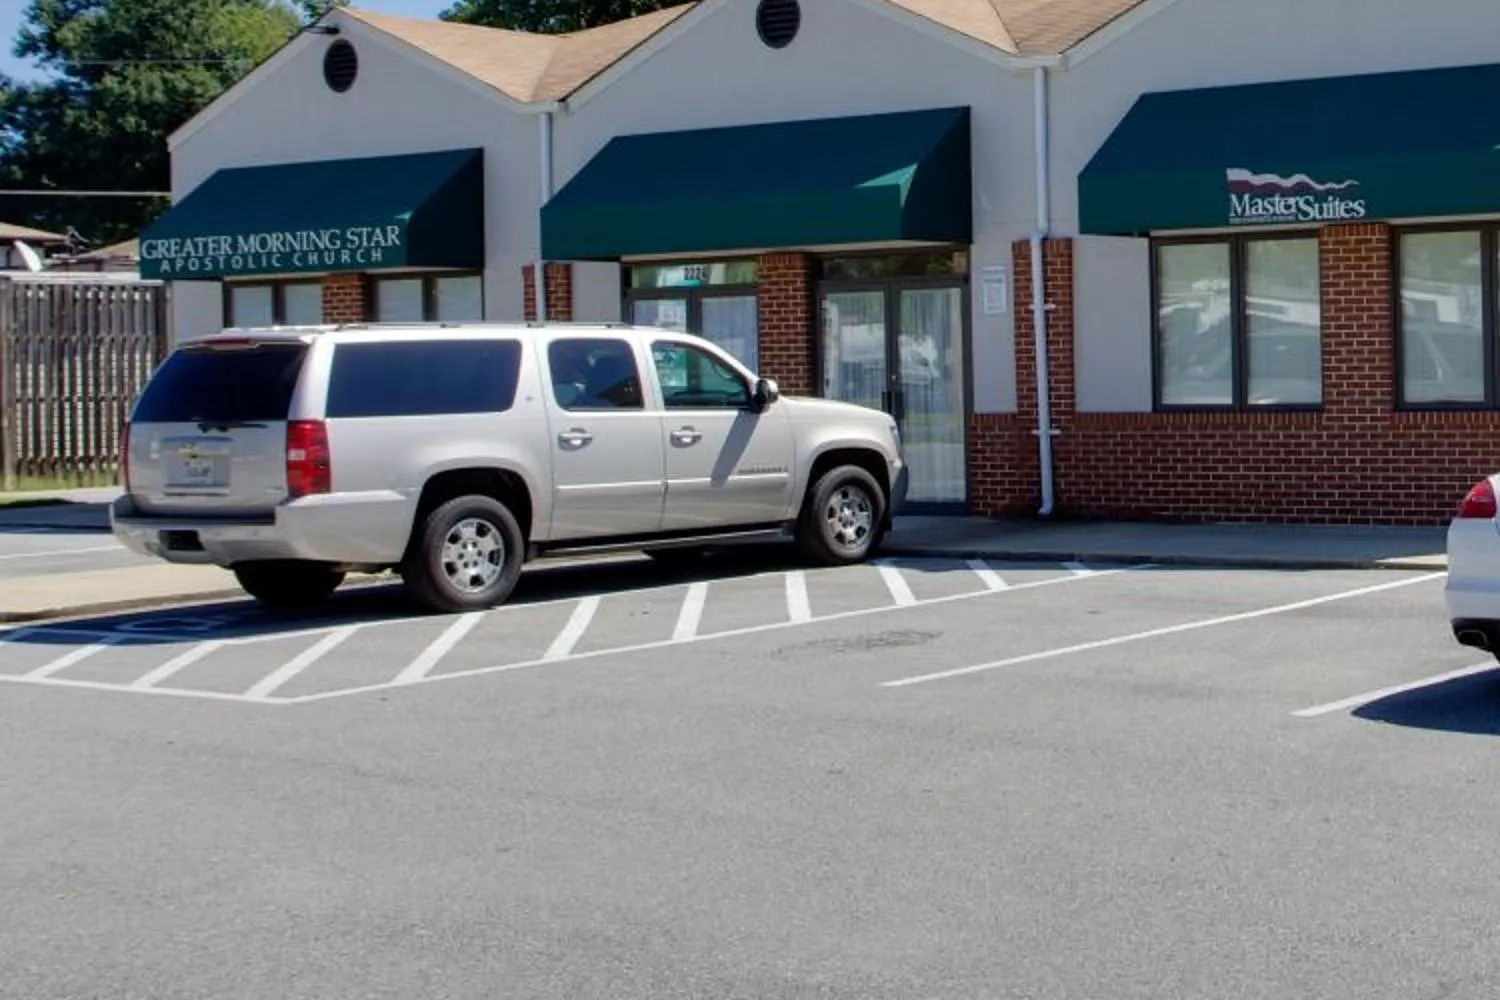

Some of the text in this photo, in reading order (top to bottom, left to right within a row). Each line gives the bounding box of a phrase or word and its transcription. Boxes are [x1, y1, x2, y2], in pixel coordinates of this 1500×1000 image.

[1229, 193, 1366, 220] MasterSuites
[142, 226, 401, 260] GREATER MORNING STAR
[160, 248, 383, 272] APOSTOLIC CHURCH
